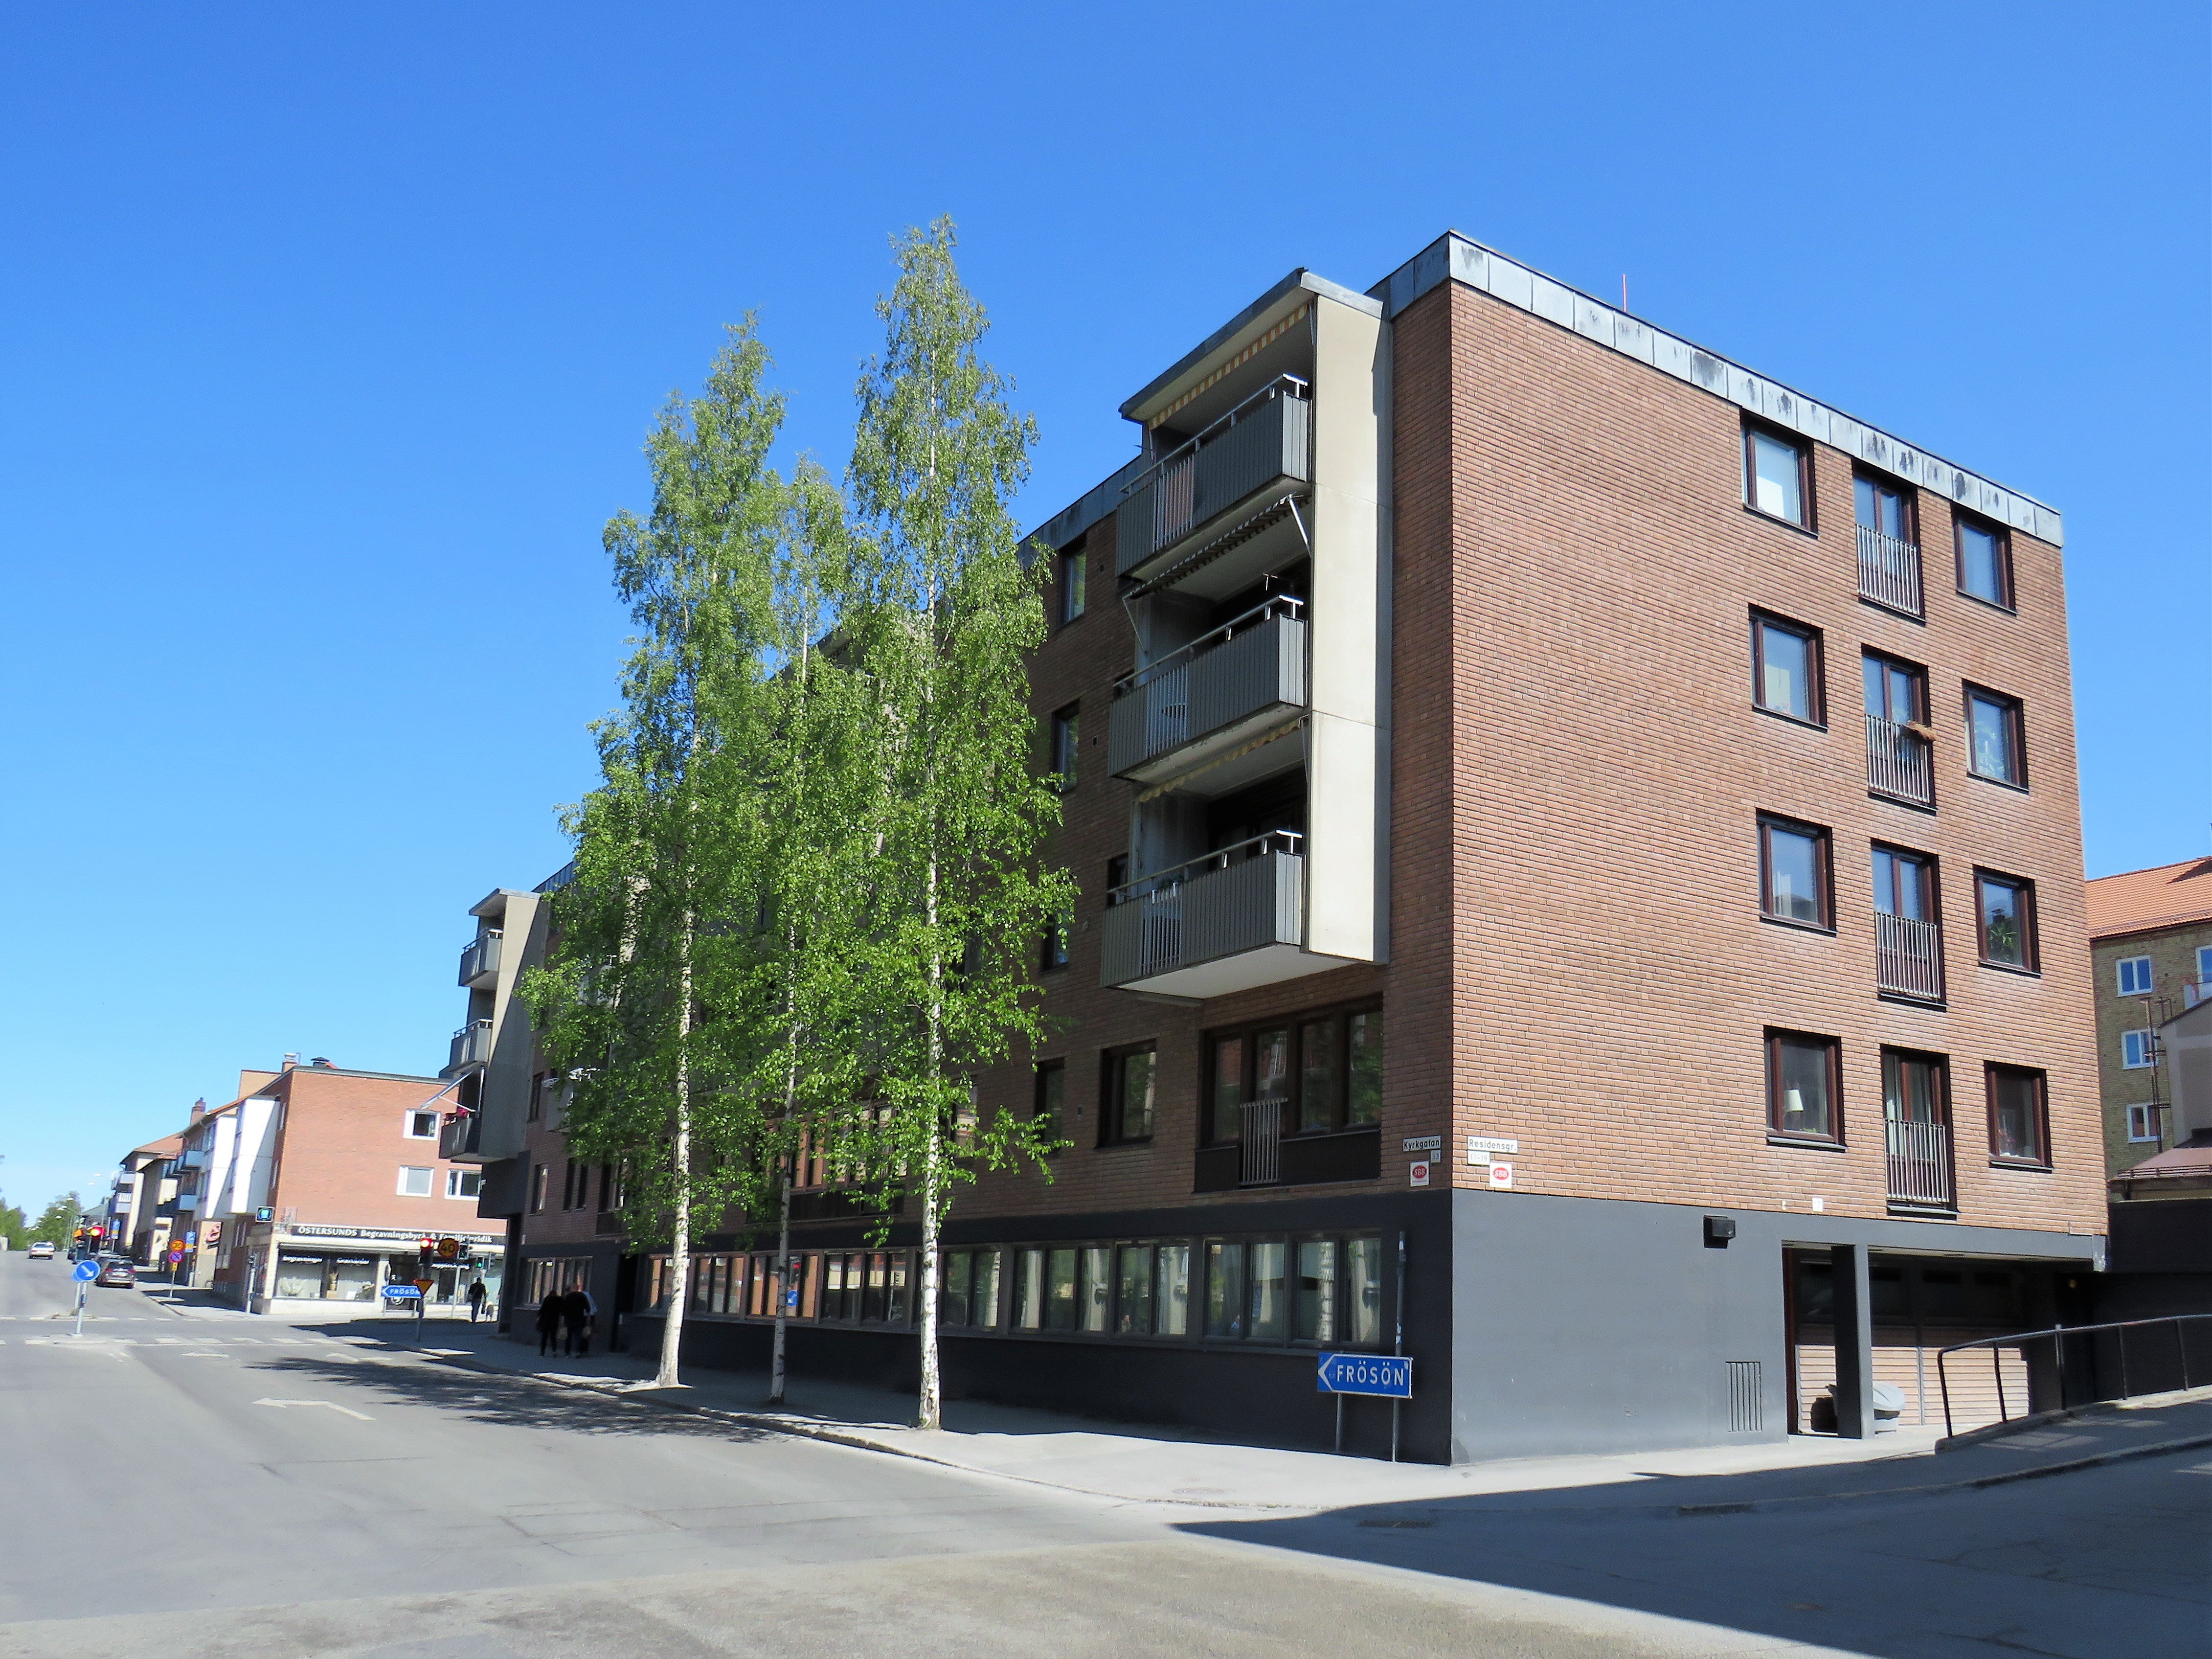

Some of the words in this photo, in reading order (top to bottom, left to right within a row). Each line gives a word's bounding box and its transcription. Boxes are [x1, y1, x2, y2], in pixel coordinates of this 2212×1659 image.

[1404, 1139, 1440, 1151] Kyrkgatan
[1469, 1139, 1516, 1152] Residensgr.
[1494, 1170, 1507, 1178] SBB
[298, 1226, 358, 1237] ÖSTERSUNDS
[361, 1229, 426, 1241] Begravningsbyrå
[441, 1242, 456, 1252] 40
[1337, 1360, 1404, 1386] FRÖSÖN
